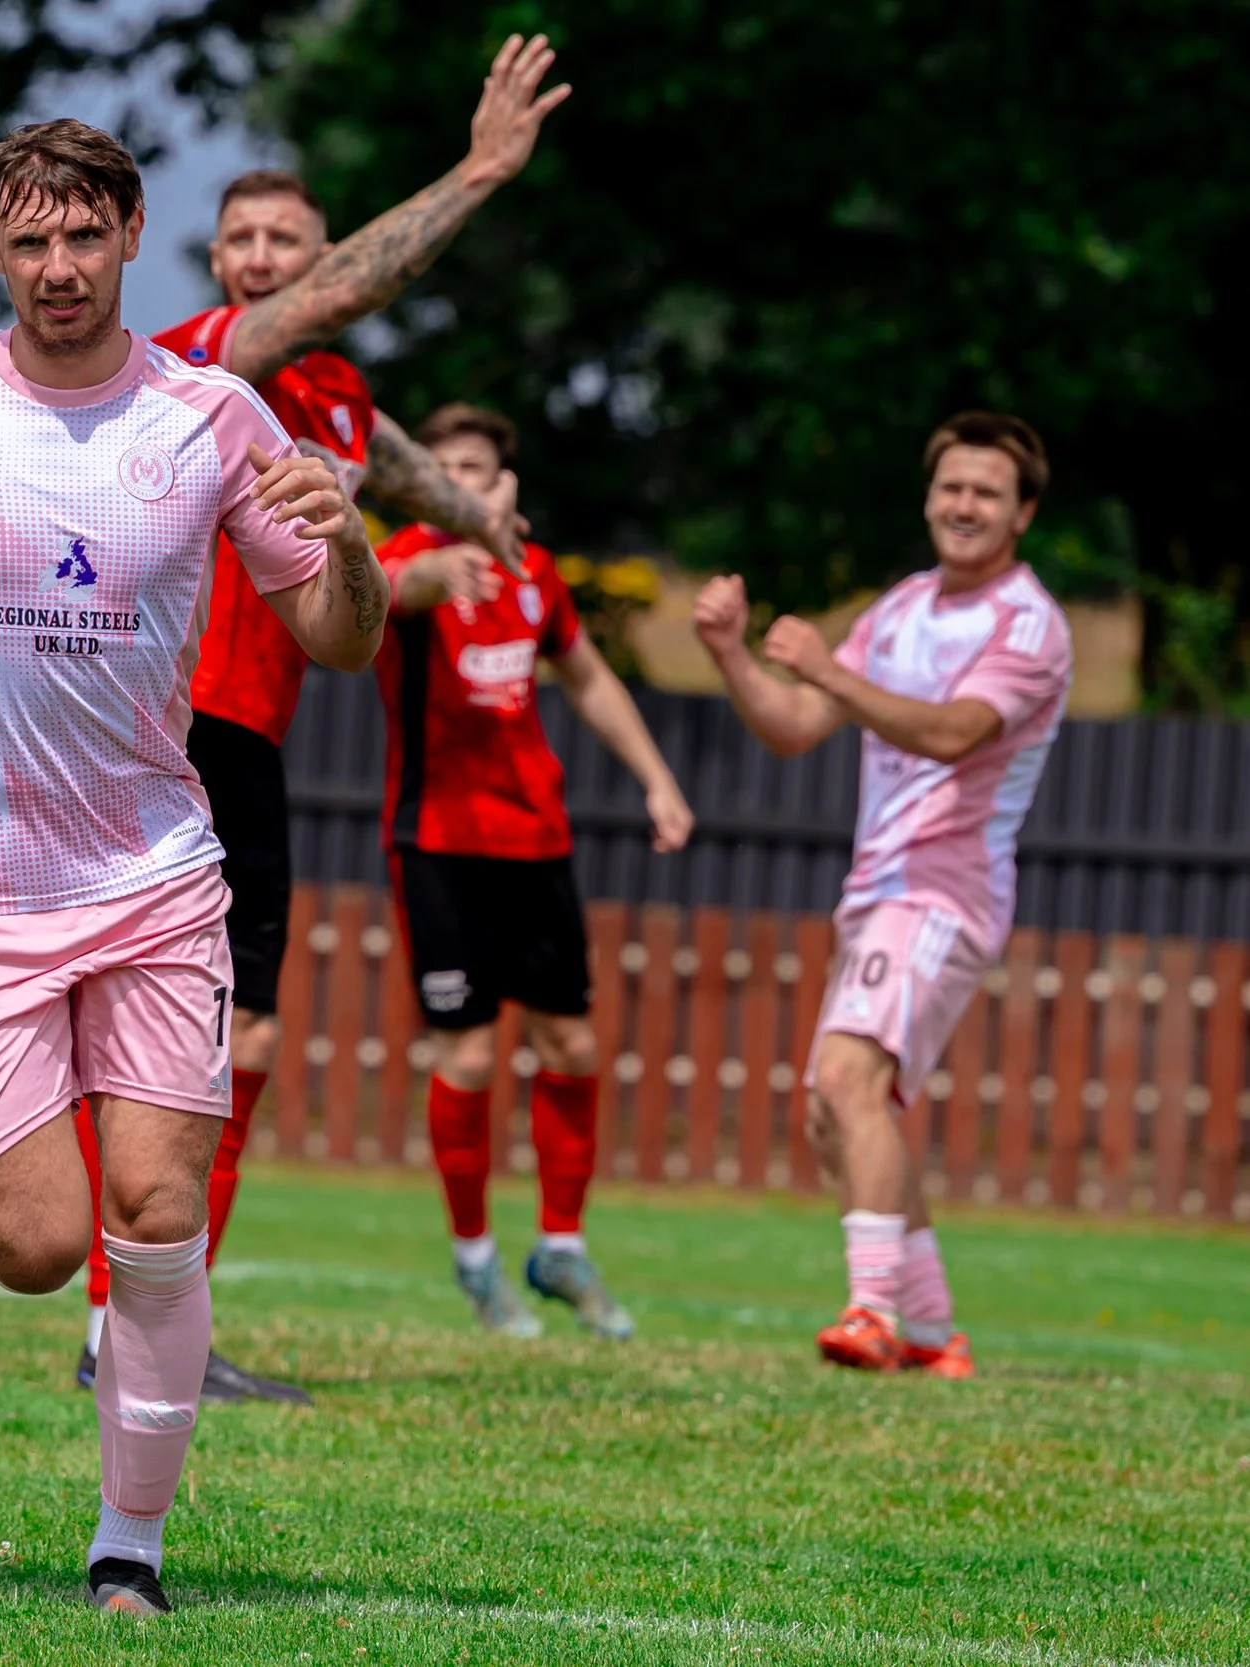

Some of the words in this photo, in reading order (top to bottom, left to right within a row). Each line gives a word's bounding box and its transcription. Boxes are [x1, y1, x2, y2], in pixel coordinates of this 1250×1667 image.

[79, 611, 141, 631] STEELS
[34, 635, 60, 653] UK
[66, 636, 103, 655] LTD.
